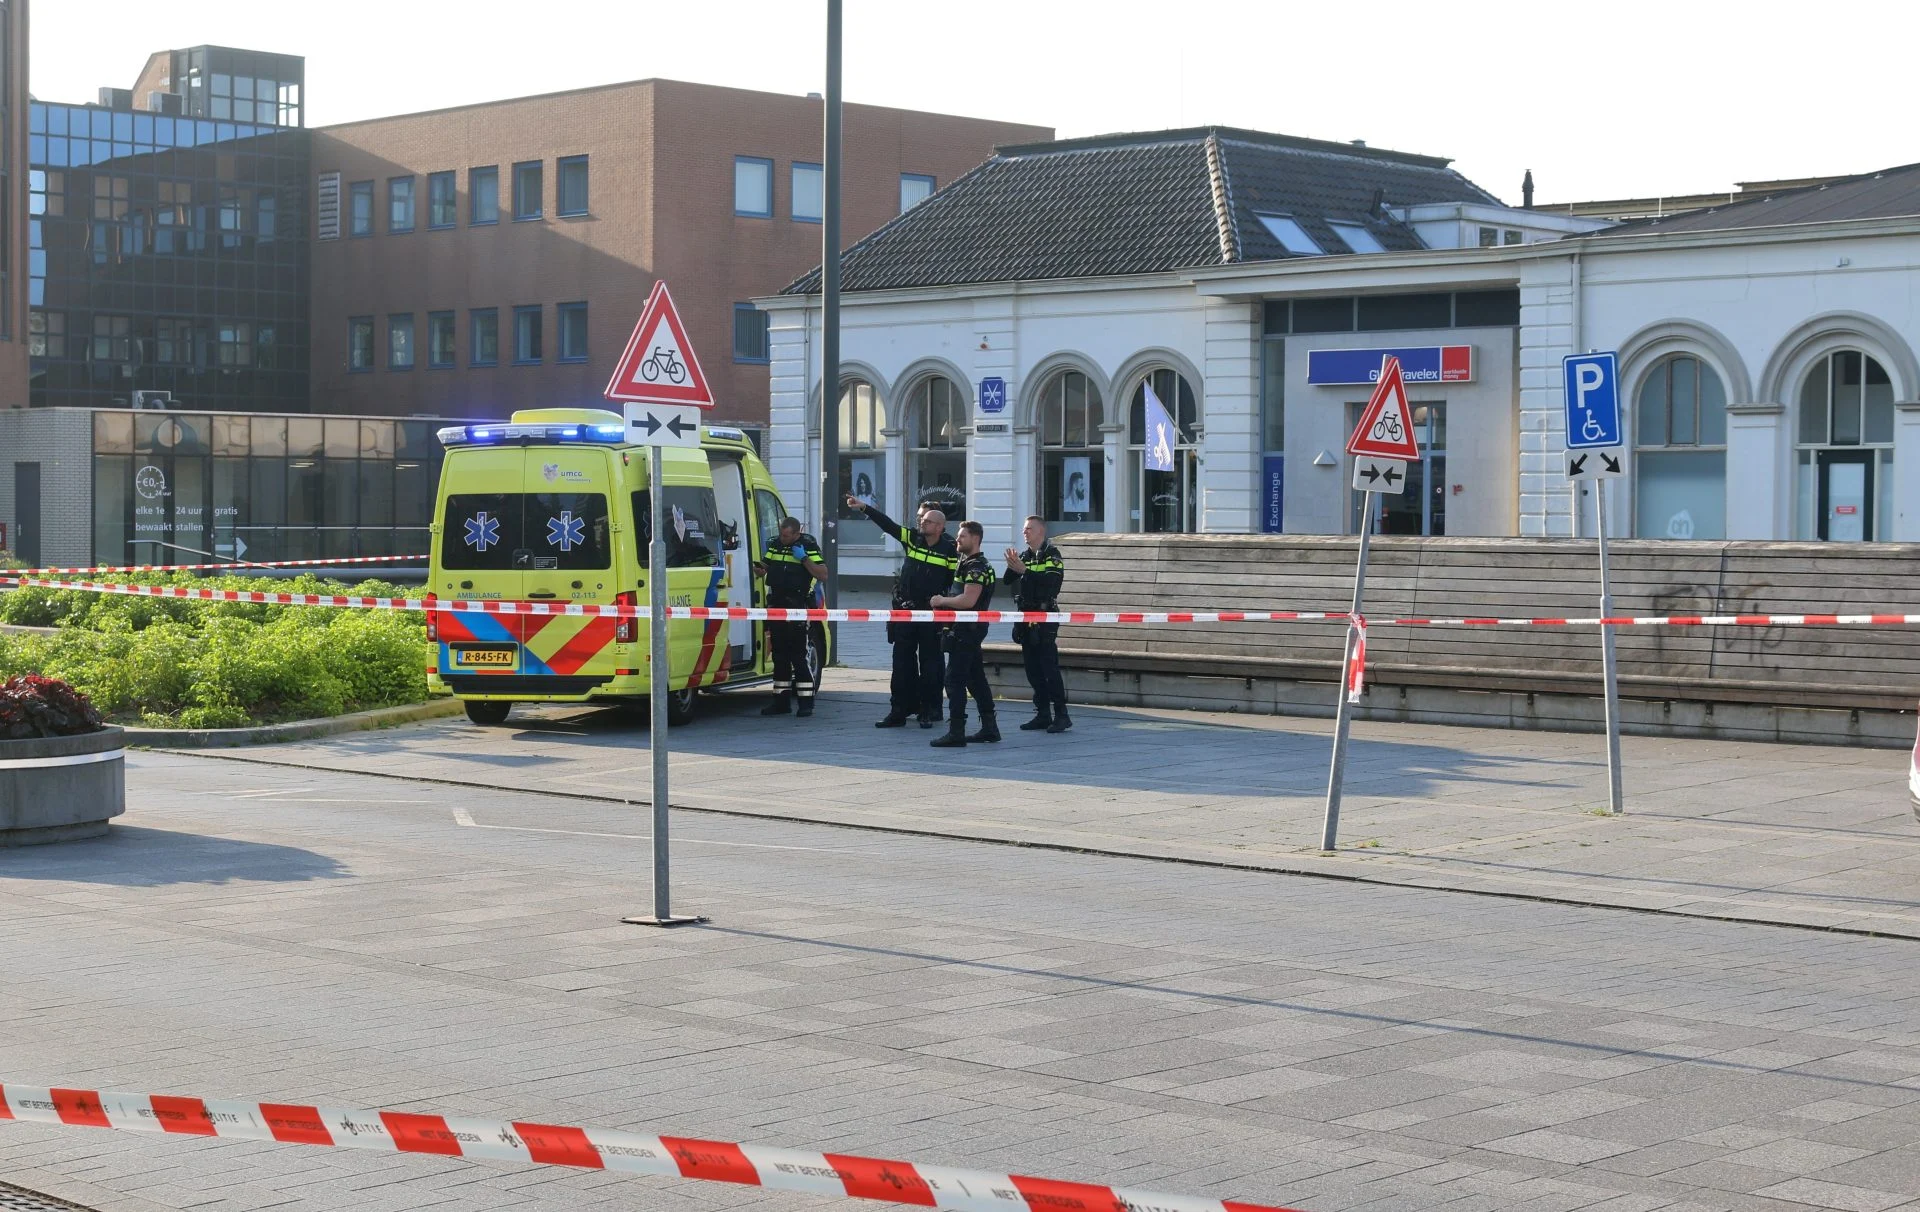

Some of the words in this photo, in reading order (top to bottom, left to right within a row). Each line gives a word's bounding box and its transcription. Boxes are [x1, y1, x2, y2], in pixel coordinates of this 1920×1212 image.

[1402, 368, 1438, 380] ravelex
[1575, 363, 1604, 408] P
[1270, 472, 1281, 526] Exchange
[135, 506, 153, 515] elke
[156, 507, 165, 515] 1e
[175, 506, 187, 515] 24
[188, 507, 203, 515] uur
[214, 506, 238, 517] gratis
[135, 522, 173, 532] bewaakt
[175, 522, 204, 532] stallen
[669, 594, 692, 606] ULANCE
[465, 652, 509, 662] R-845-FK
[340, 1114, 384, 1136] POLITIE
[437, 1131, 483, 1143] BETREDEN
[608, 1144, 657, 1159] BETREDEN
[774, 1162, 797, 1175] NIET
[799, 1164, 858, 1181] BETREDEN
[991, 1187, 1018, 1200] NIET
[1019, 1191, 1086, 1210] BETREDEN
